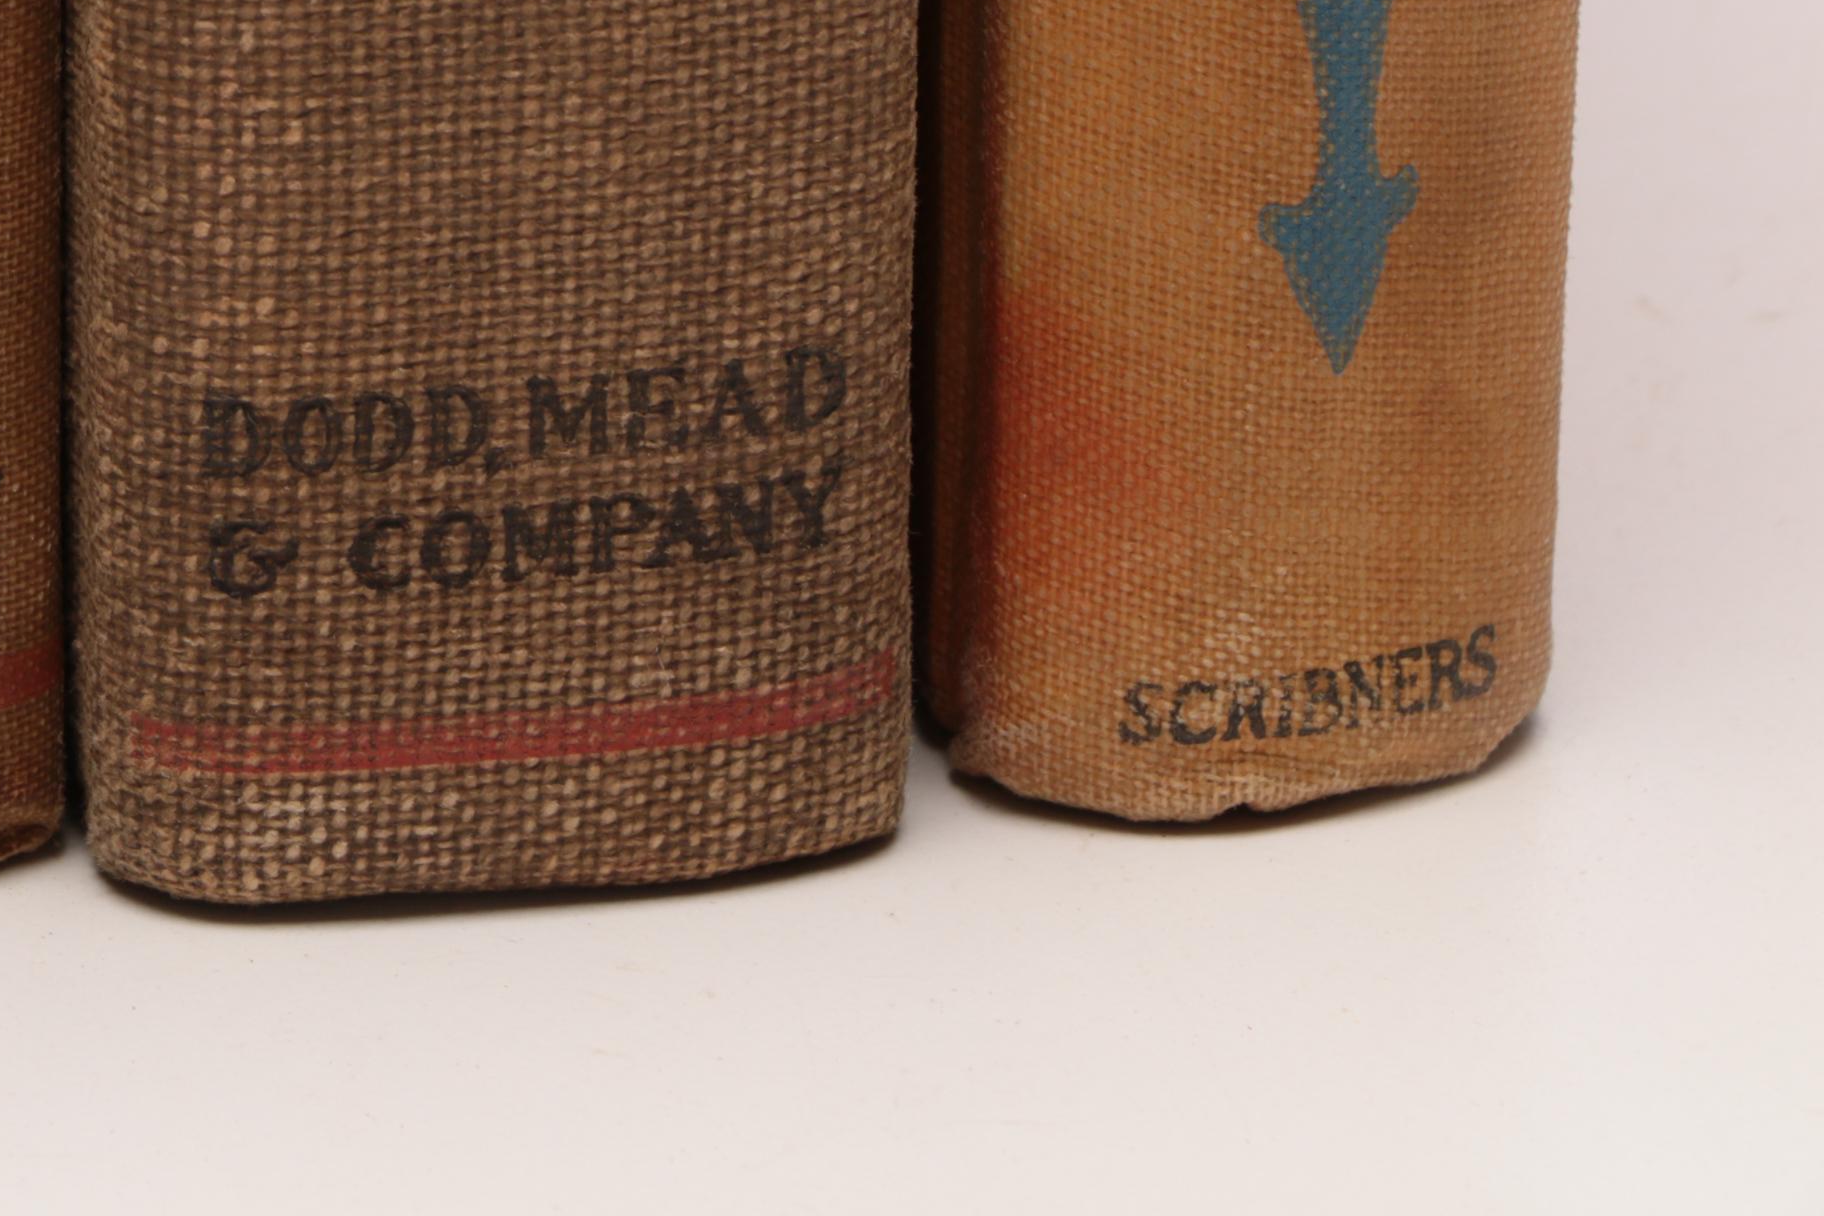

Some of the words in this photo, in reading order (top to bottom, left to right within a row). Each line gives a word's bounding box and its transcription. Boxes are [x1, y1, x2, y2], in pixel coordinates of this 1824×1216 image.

[524, 344, 848, 461] MEAD
[208, 519, 299, 599] &
[348, 462, 842, 590] COMPANY
[1117, 622, 1499, 746] SCRIBNERS
